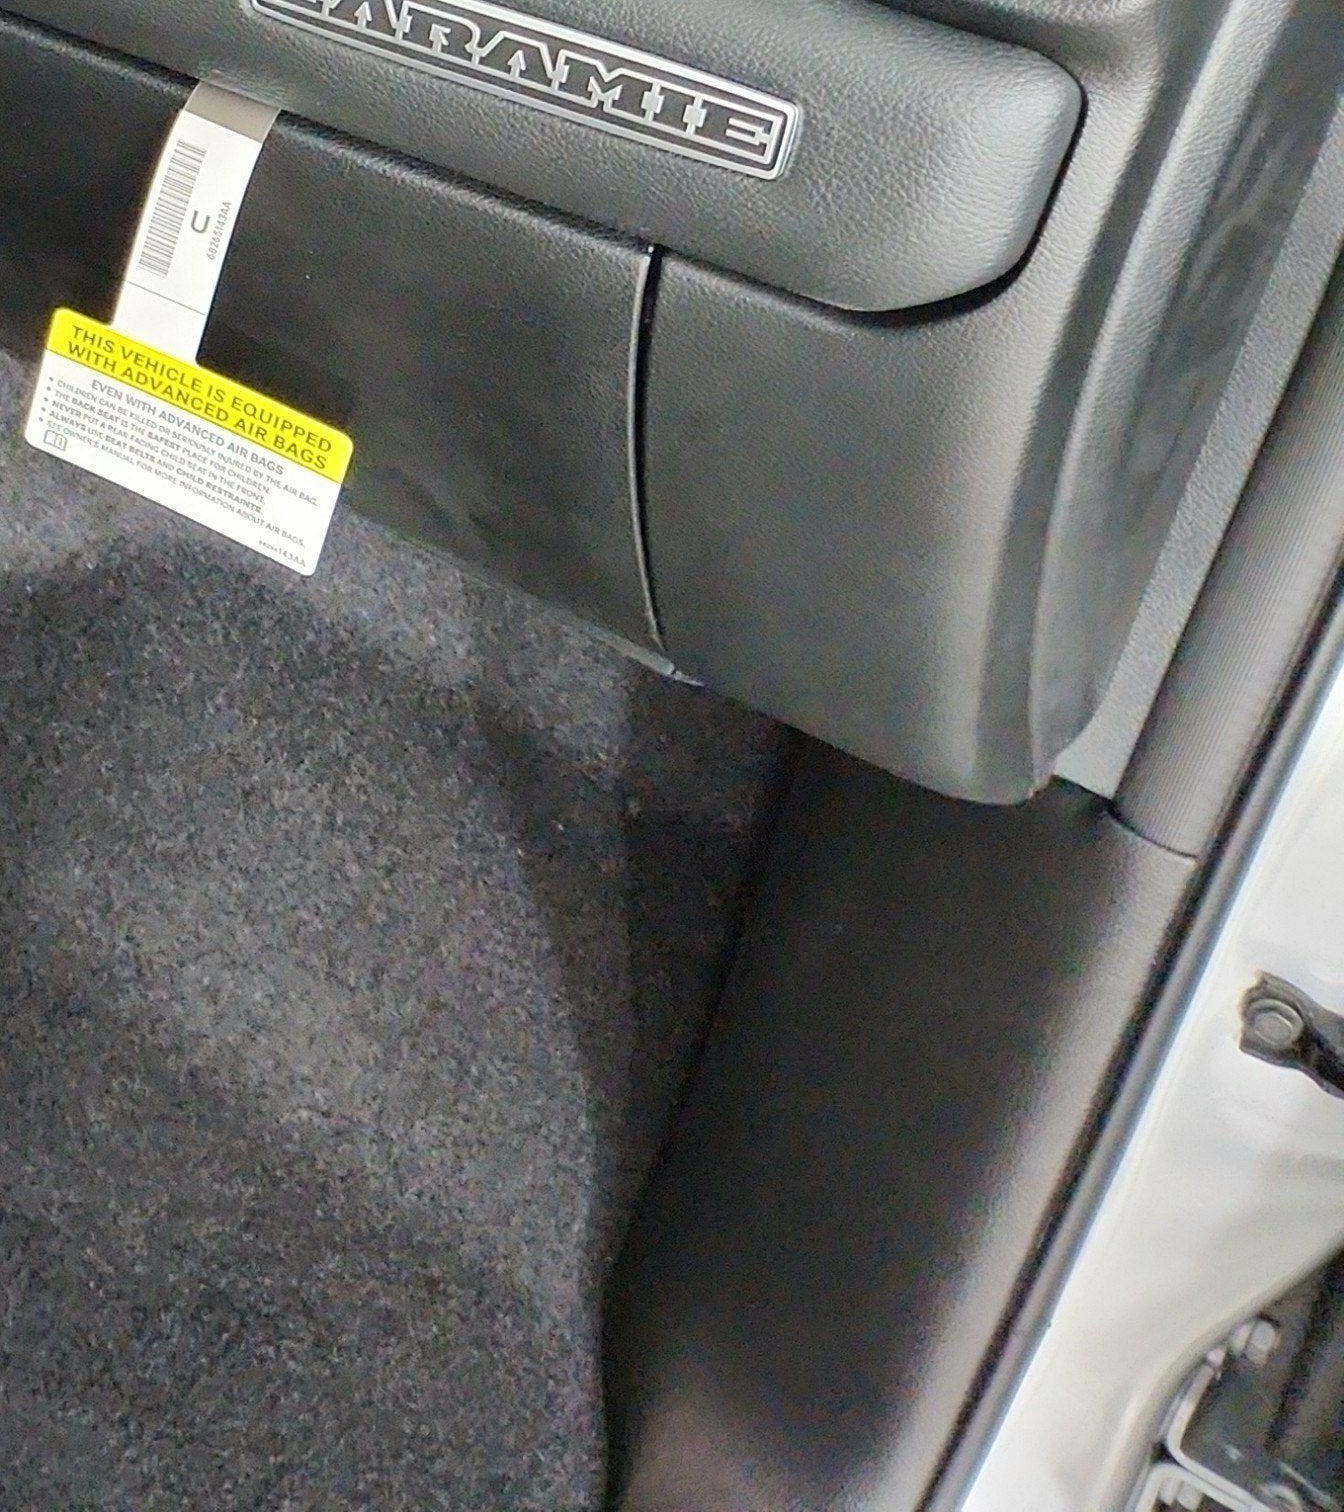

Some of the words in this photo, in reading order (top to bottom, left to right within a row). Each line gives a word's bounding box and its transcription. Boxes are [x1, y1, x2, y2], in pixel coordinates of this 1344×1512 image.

[191, 209, 211, 234] U
[66, 340, 116, 372] WITH
[120, 364, 229, 423] ADVANCED
[233, 415, 267, 441] AIR
[272, 433, 327, 470] BAGS
[71, 324, 115, 354] THIS
[119, 346, 202, 393] VEHICLE
[206, 384, 226, 404] IS
[231, 395, 332, 454] EQUIPPED
[91, 378, 122, 400] EVEN
[124, 393, 156, 415] WITH
[158, 409, 225, 447] ADVANCED
[226, 440, 248, 458] AIR
[250, 451, 284, 475] BAGS
